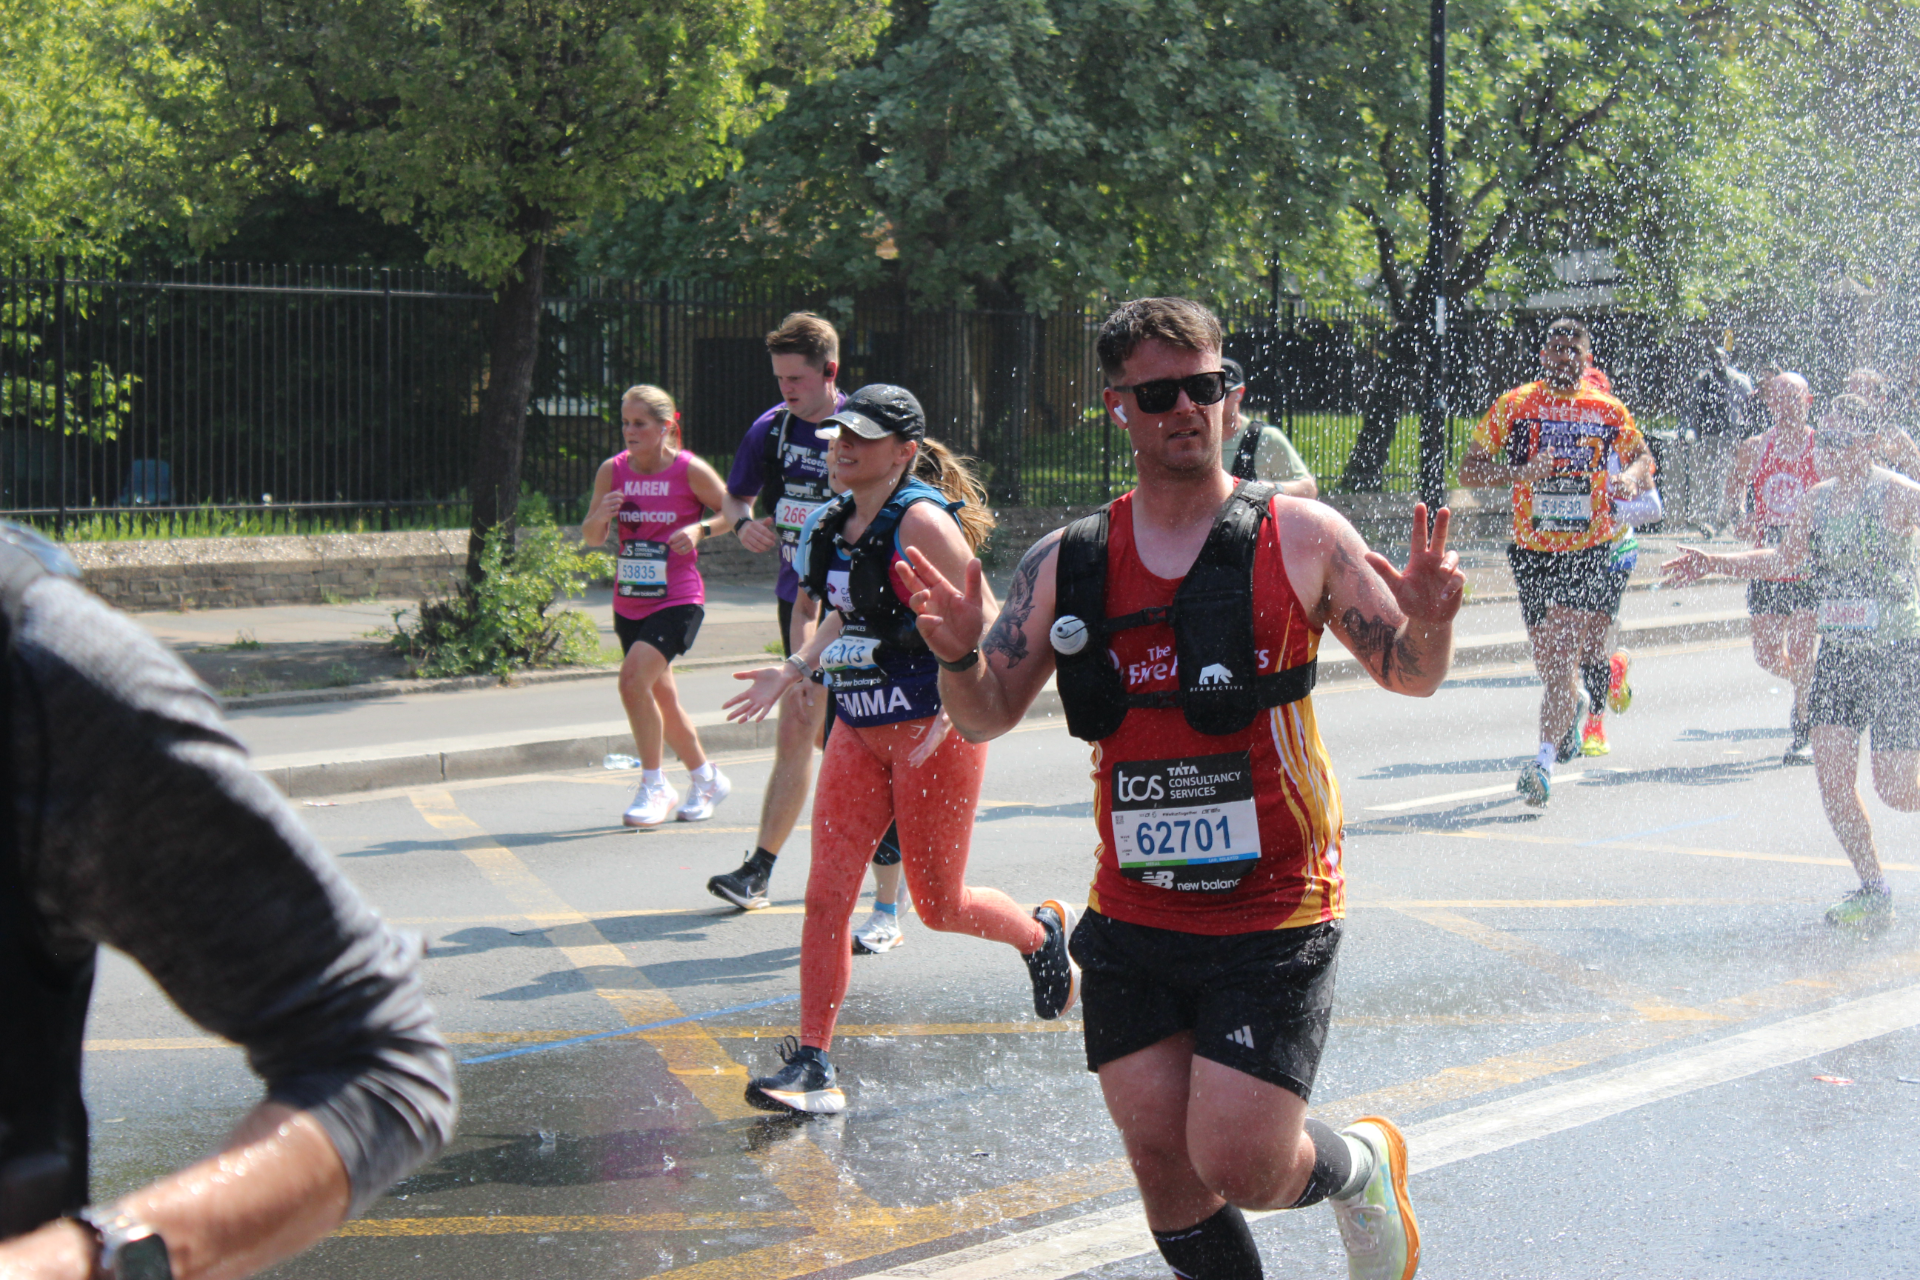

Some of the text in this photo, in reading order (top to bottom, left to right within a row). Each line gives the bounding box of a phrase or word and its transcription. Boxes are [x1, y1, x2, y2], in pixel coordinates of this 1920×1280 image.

[1538, 406, 1604, 424] STEFAN
[624, 481, 669, 496] KAREN
[619, 511, 677, 525] mencap
[783, 505, 814, 525] 266
[622, 564, 656, 579] 53835
[1128, 660, 1168, 685] Fire
[835, 686, 912, 717] EMMA
[1167, 765, 1199, 776] TATA
[1118, 770, 1165, 802] tcs
[1168, 771, 1241, 788] CONSULTANCY
[1170, 786, 1217, 800] SERVICES
[1136, 815, 1231, 856] 62701
[1177, 878, 1241, 891] new balanc
